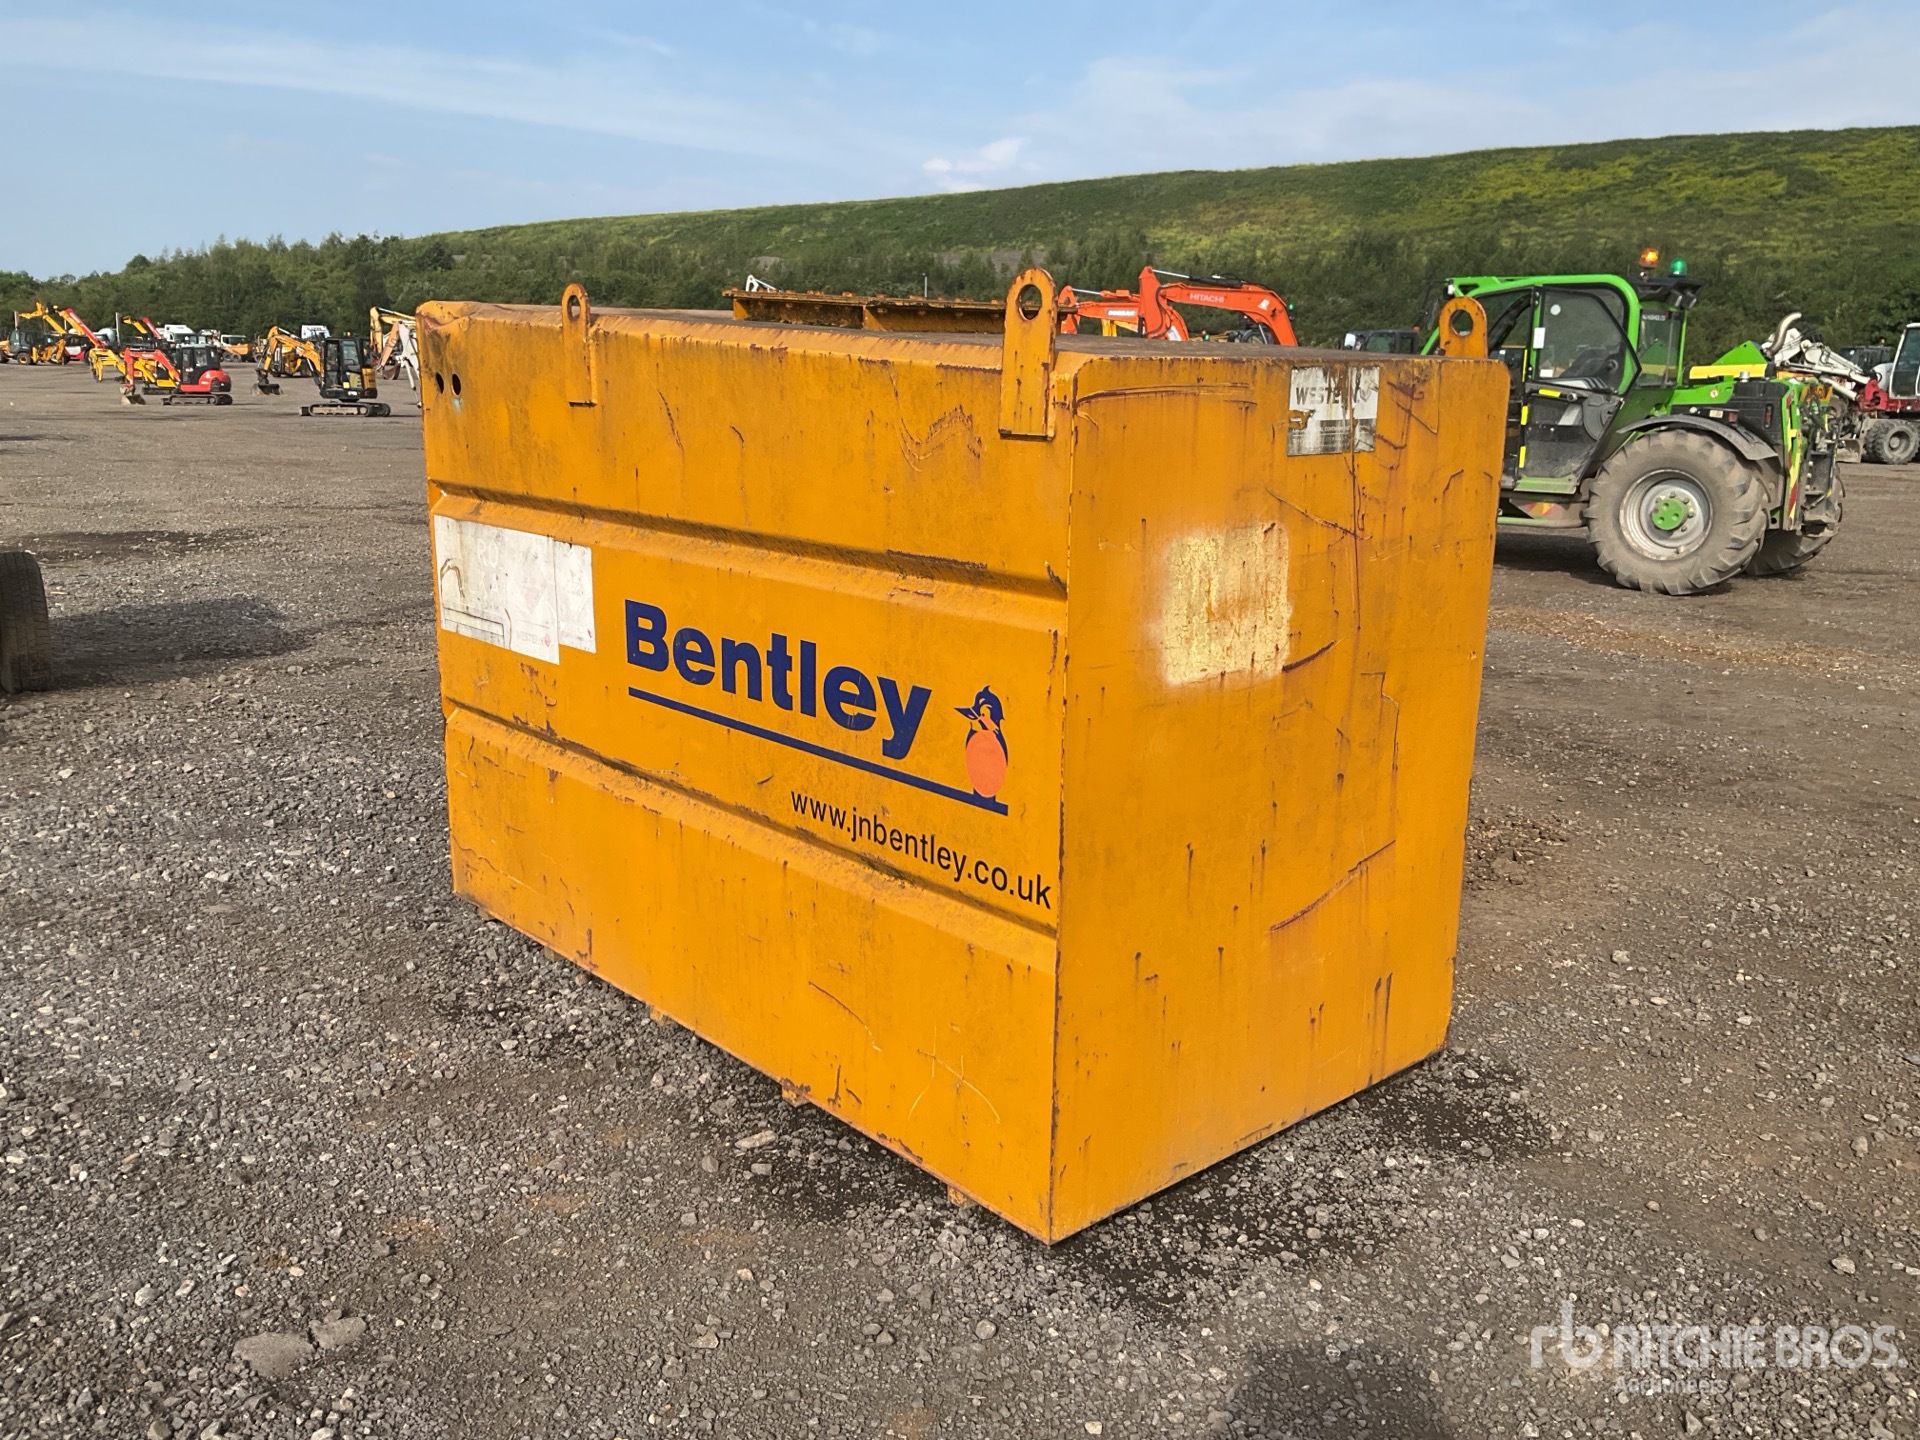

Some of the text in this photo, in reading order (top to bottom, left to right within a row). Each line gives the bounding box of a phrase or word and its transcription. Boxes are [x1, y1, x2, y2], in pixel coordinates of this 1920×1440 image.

[1189, 293, 1225, 303] HITACHI
[1296, 386, 1357, 405] WESTEN
[625, 599, 932, 760] Bentley
[791, 791, 1052, 911] www.jnbentley.co.uk
